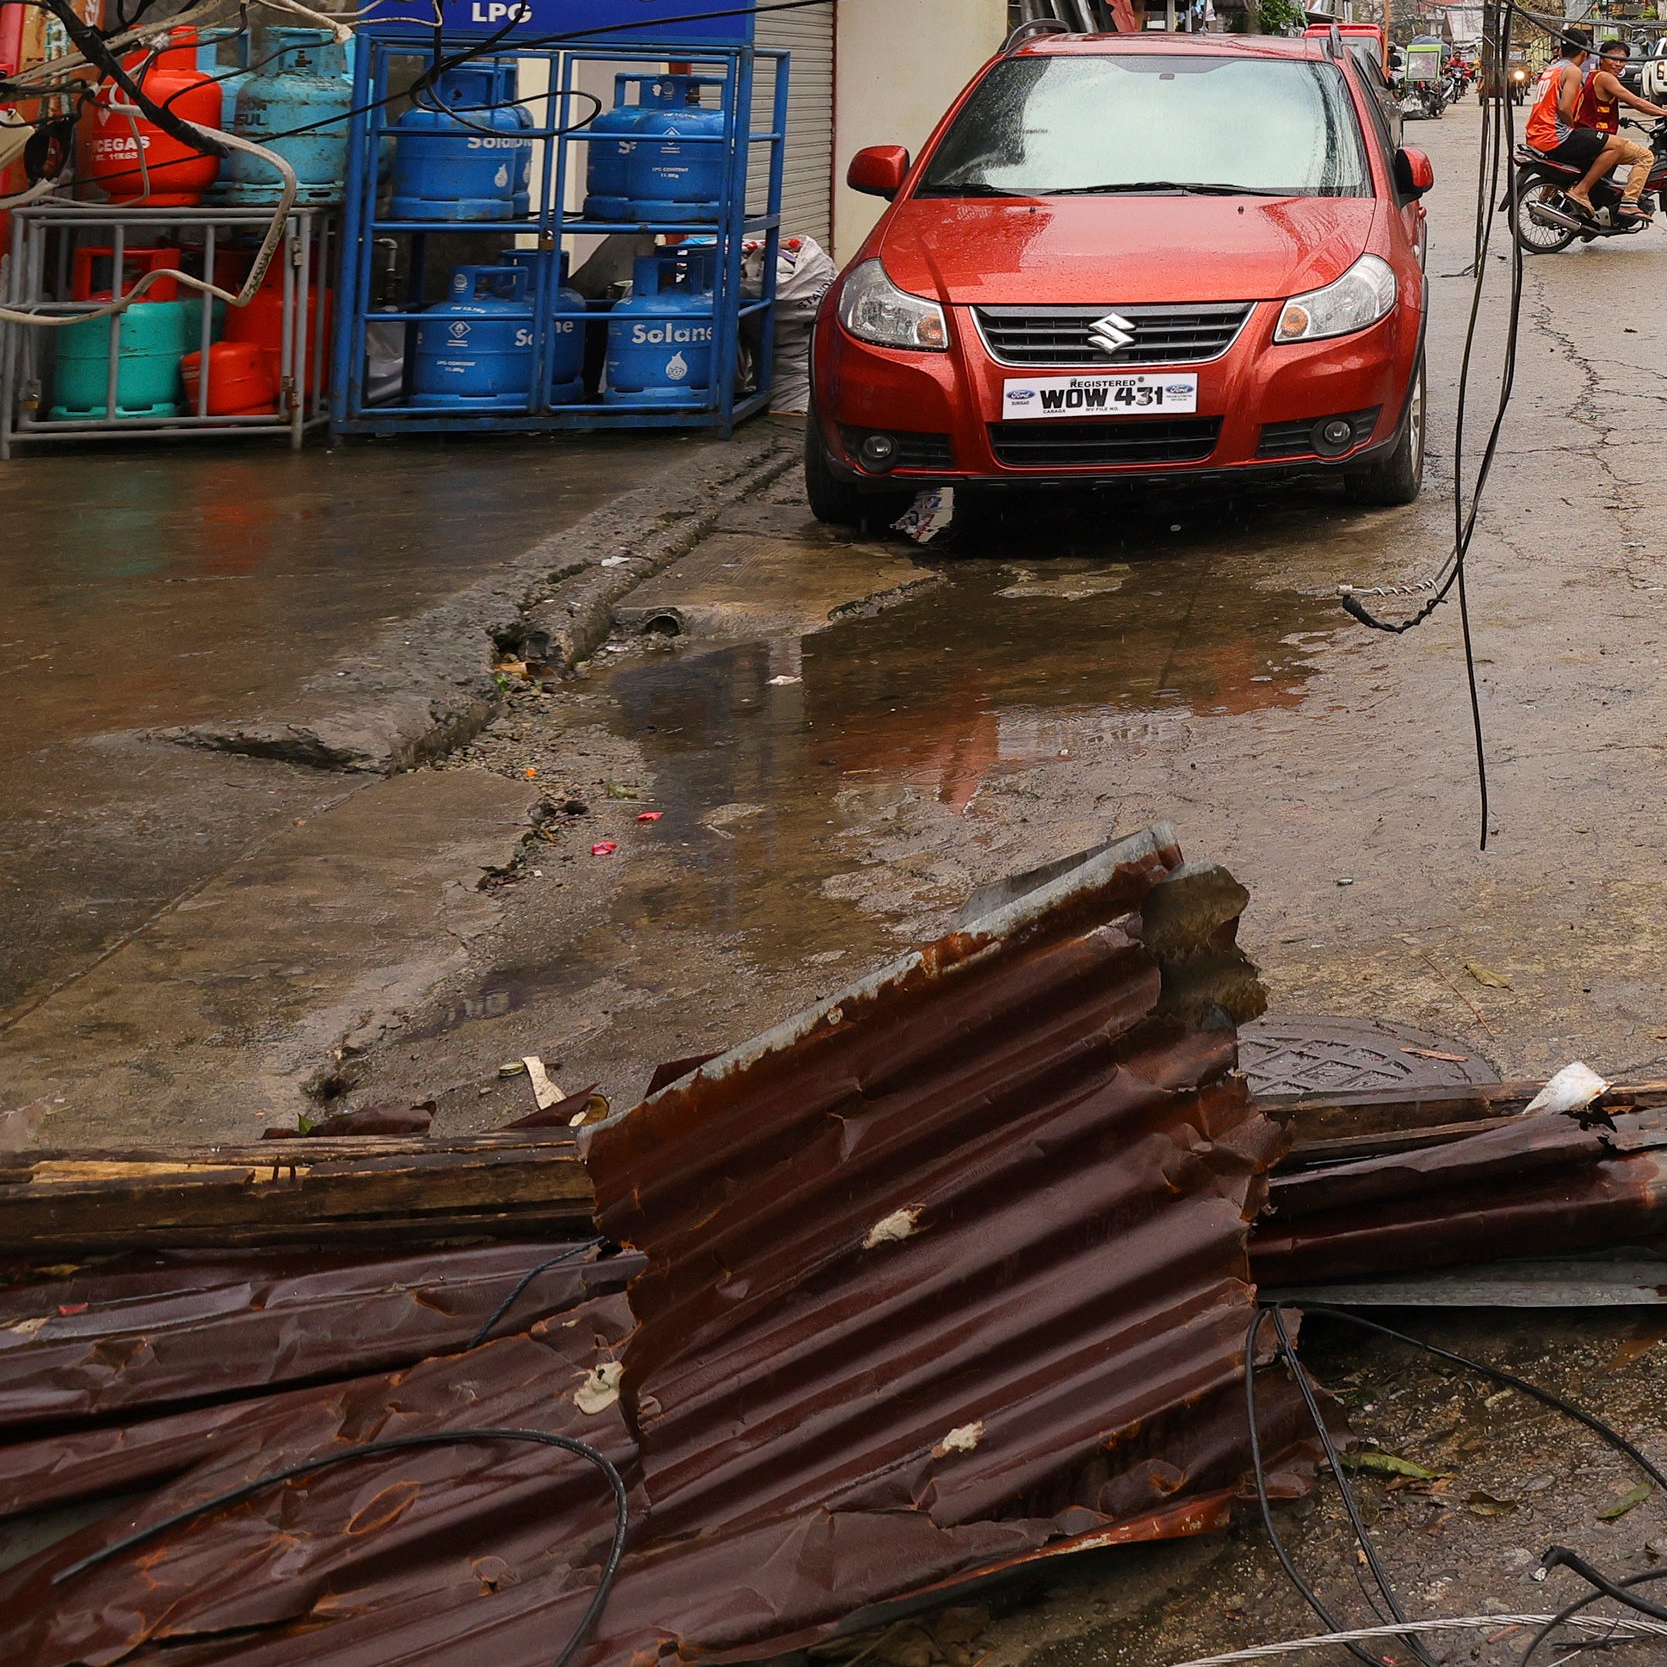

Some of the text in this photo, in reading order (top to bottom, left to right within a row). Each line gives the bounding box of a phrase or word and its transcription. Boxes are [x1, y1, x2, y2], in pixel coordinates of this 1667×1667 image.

[471, 2, 533, 24] LPG
[1070, 378, 1137, 388] REGISTERED
[1039, 387, 1109, 409] WOW
